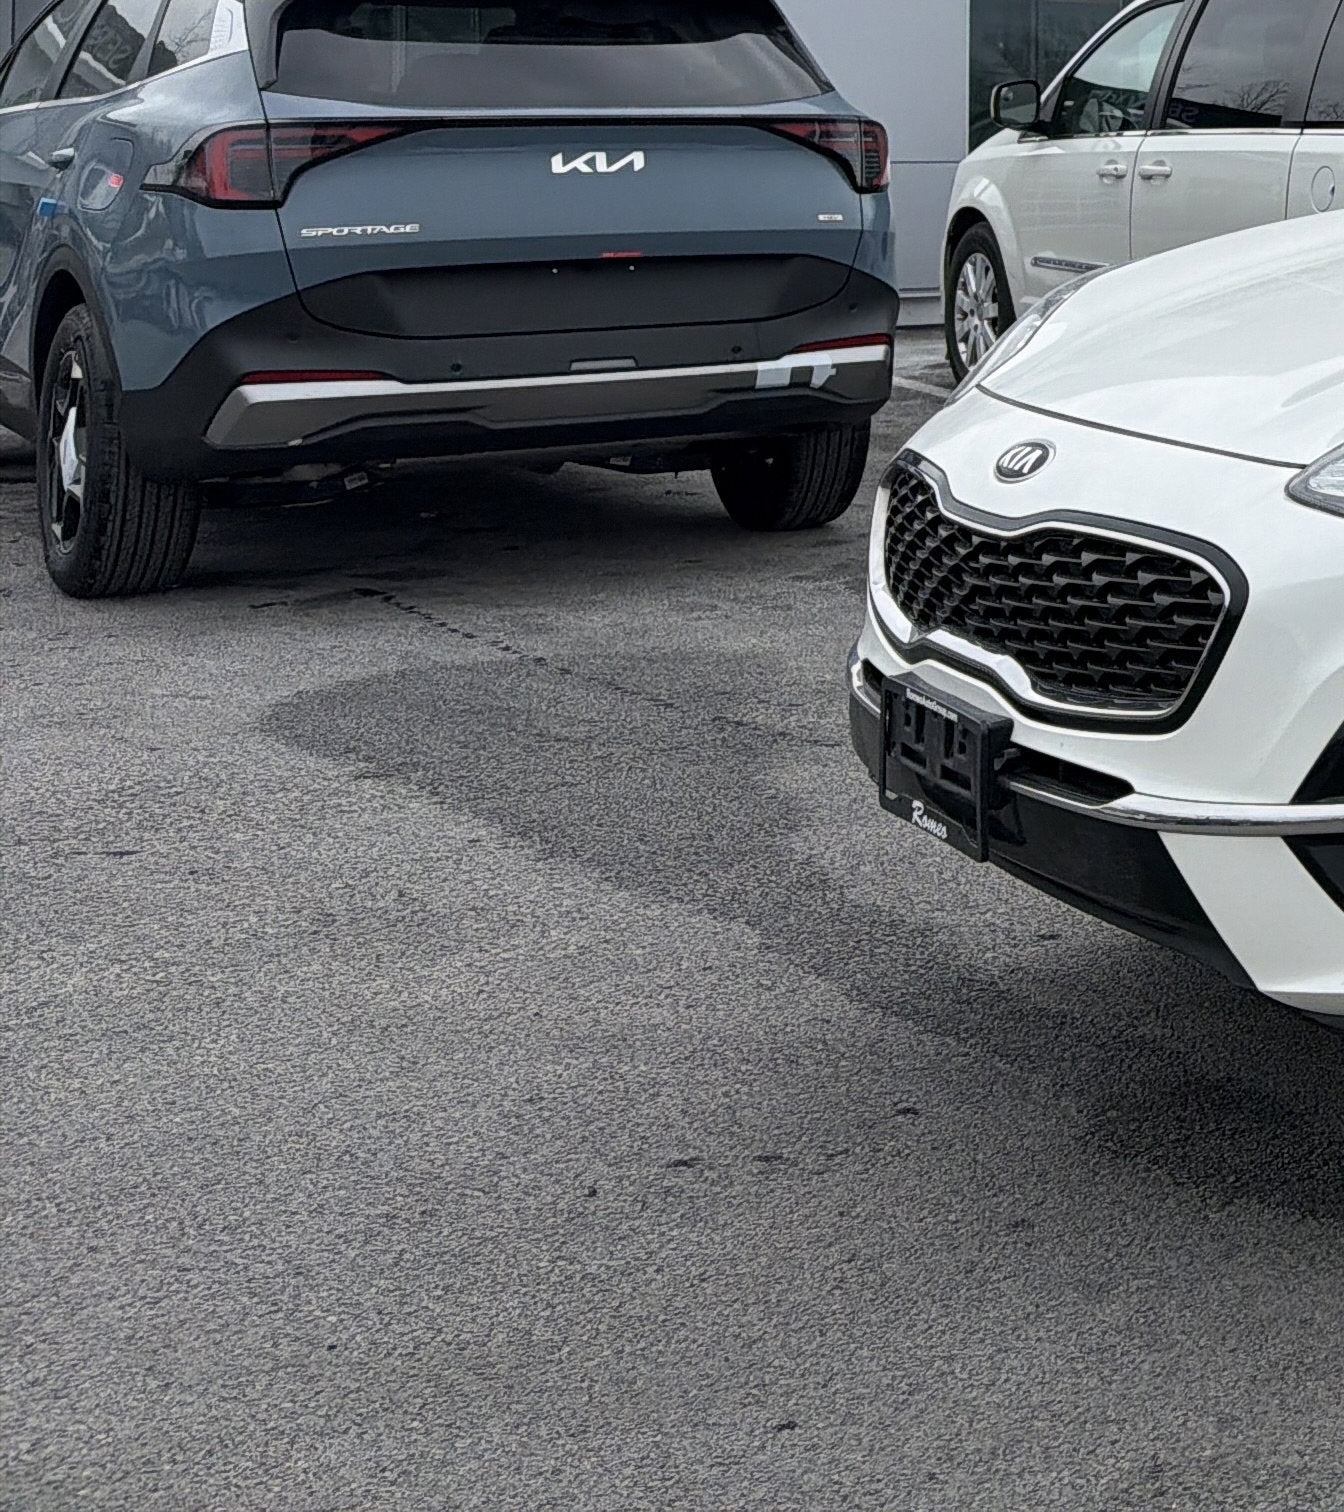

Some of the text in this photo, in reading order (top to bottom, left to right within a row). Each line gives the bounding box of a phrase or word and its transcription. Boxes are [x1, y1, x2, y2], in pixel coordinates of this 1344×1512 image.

[550, 150, 646, 175] KIA
[300, 223, 420, 237] SPORTAGE
[998, 445, 1043, 474] KIA
